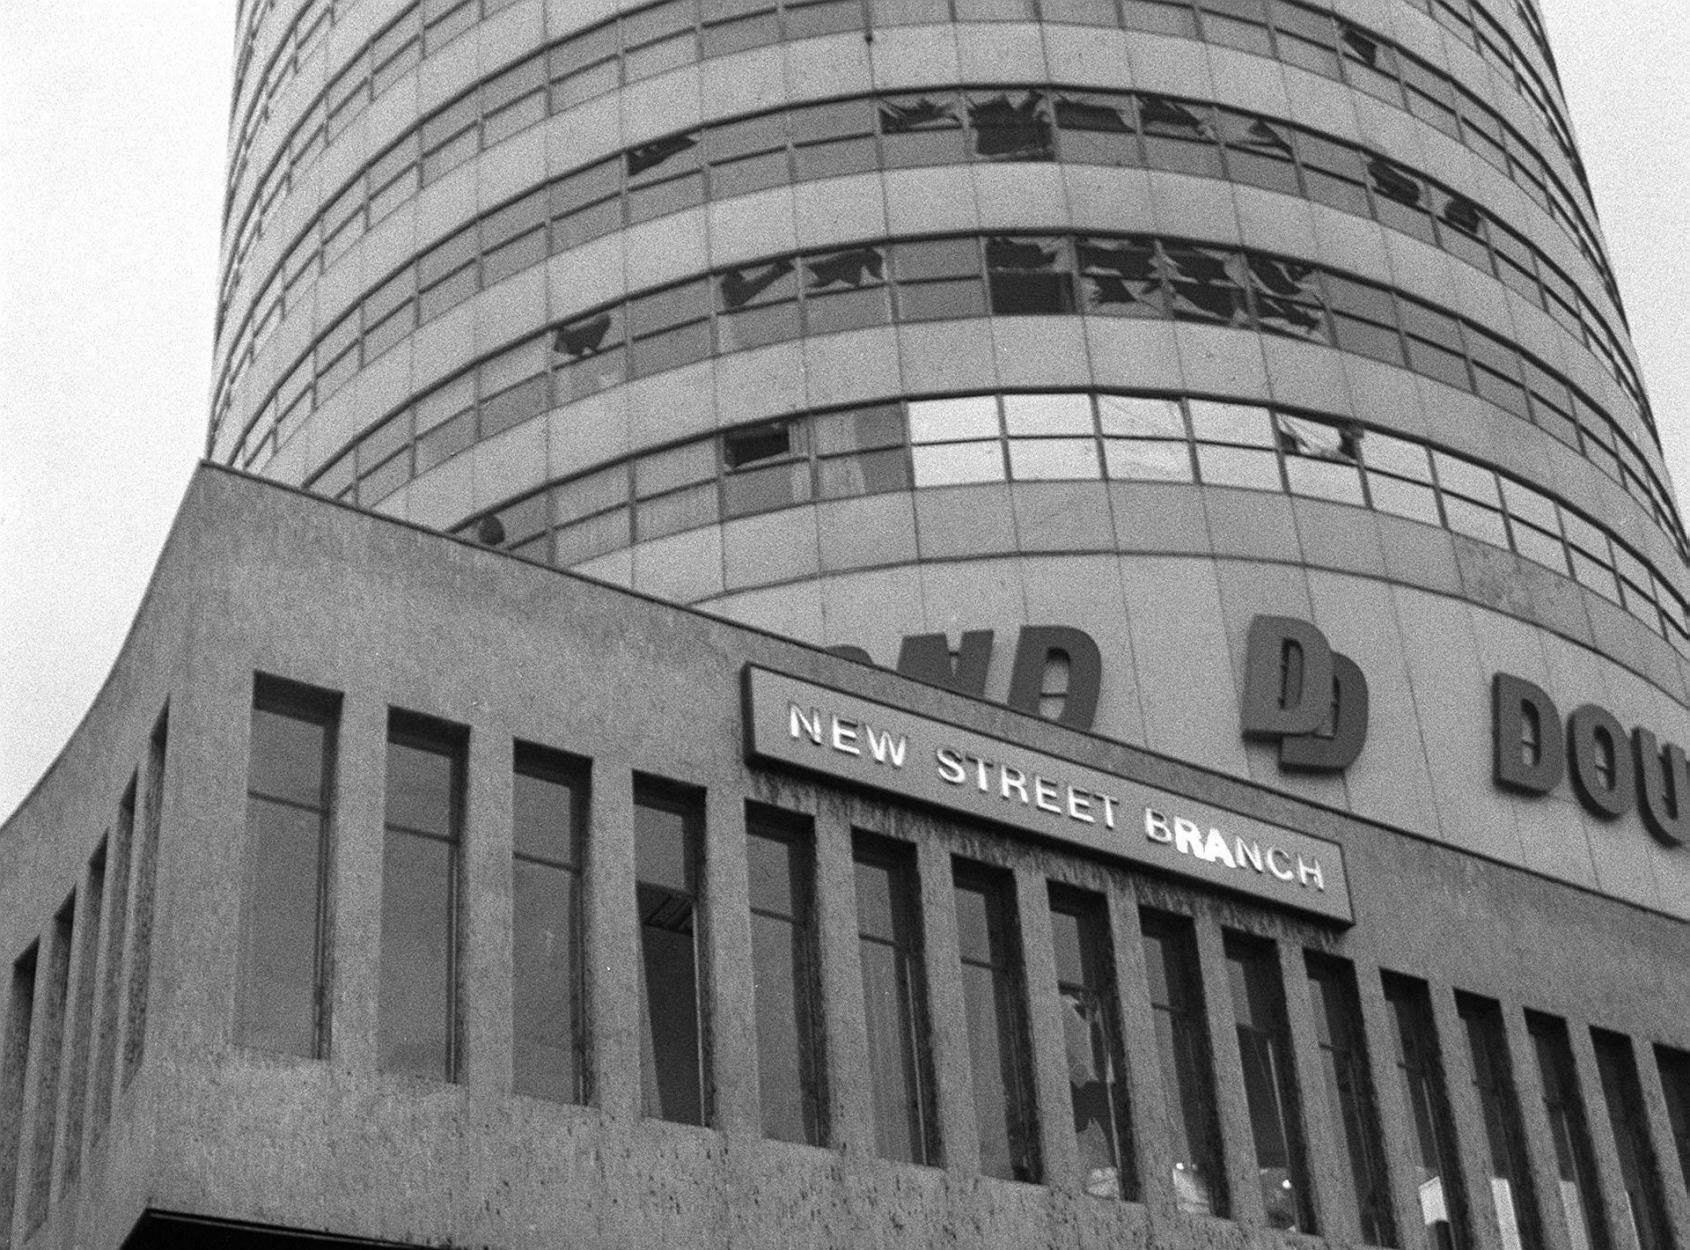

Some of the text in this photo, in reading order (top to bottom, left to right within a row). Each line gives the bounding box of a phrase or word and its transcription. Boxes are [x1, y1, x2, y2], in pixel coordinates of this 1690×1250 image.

[787, 703, 1325, 892] NEW STREET BRANCH
[1491, 671, 1690, 848] DOU
